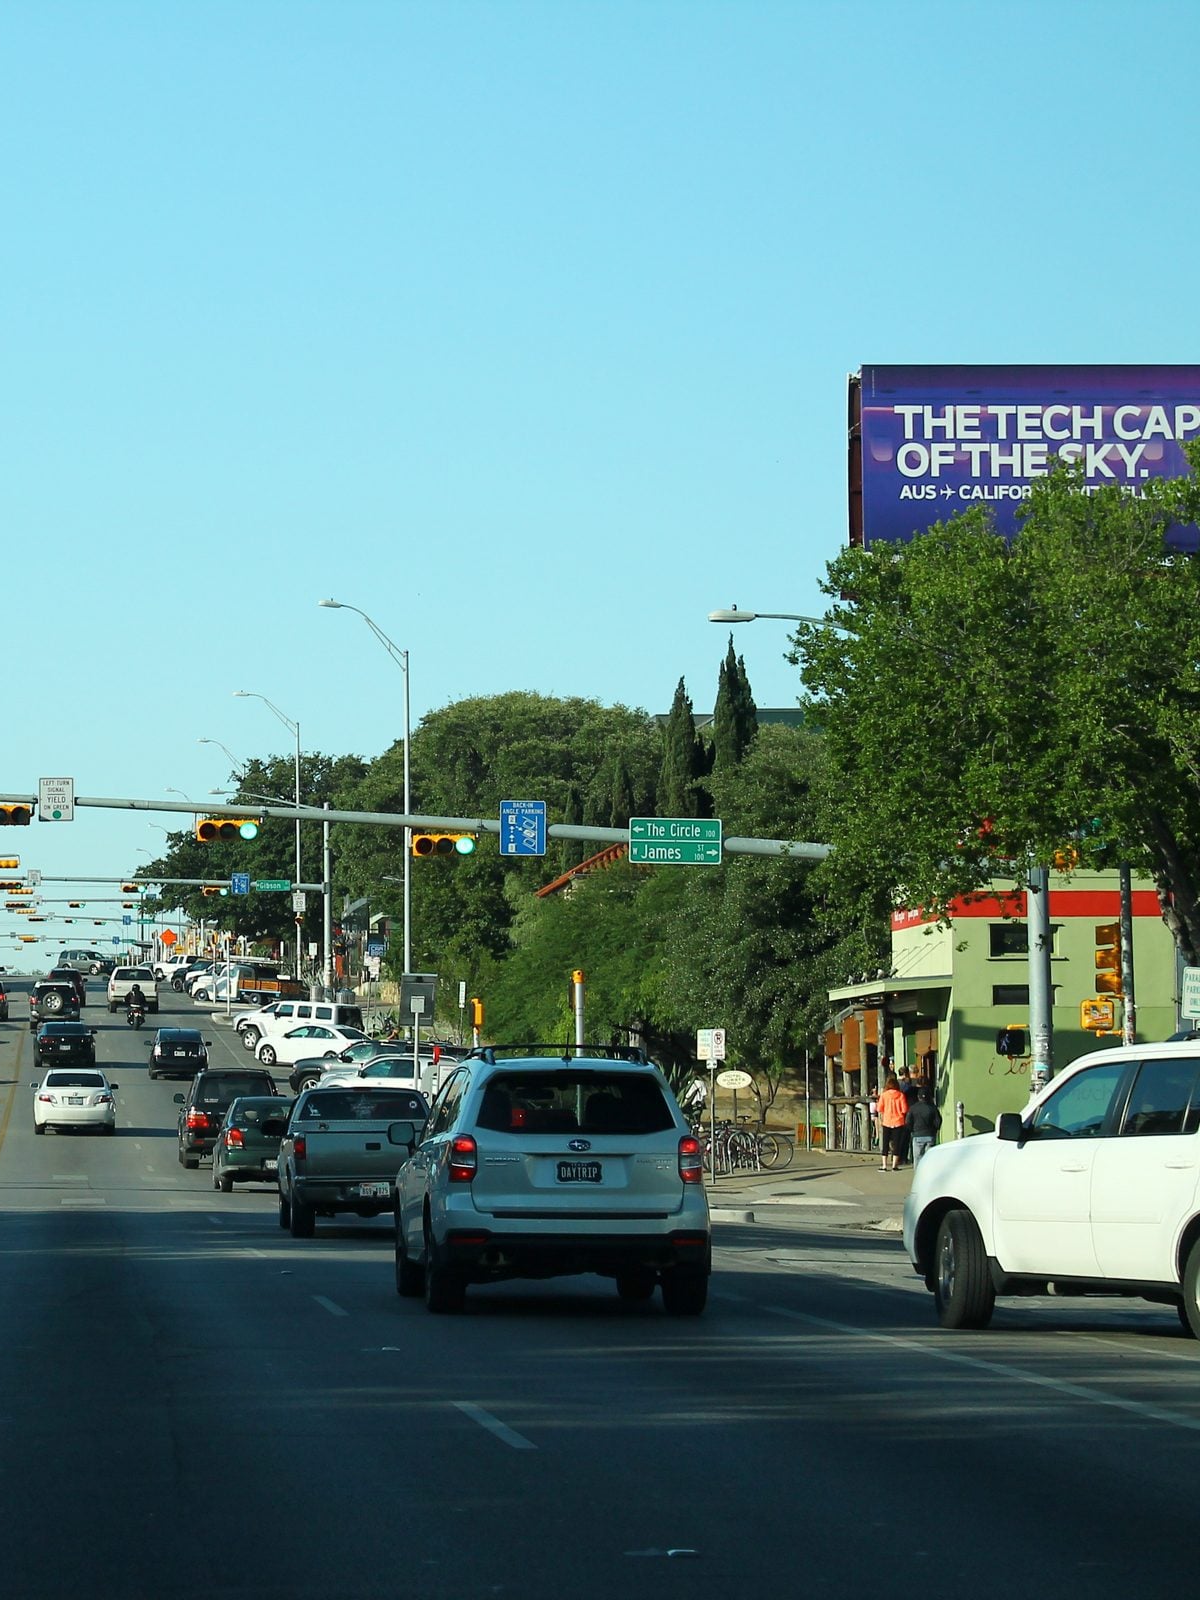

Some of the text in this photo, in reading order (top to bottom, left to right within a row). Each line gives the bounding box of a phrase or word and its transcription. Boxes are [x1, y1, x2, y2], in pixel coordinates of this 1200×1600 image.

[894, 405, 981, 440] THE
[987, 405, 1103, 440] TECH
[896, 443, 1149, 478] OF THE SKY.
[900, 484, 1032, 500] AUS CALIFOR
[47, 796, 66, 804] YIELD
[646, 823, 665, 837] The
[670, 823, 701, 837] Circle
[640, 844, 682, 860] James
[694, 853, 705, 861] 100
[560, 1166, 598, 1179] DAYTRIP
